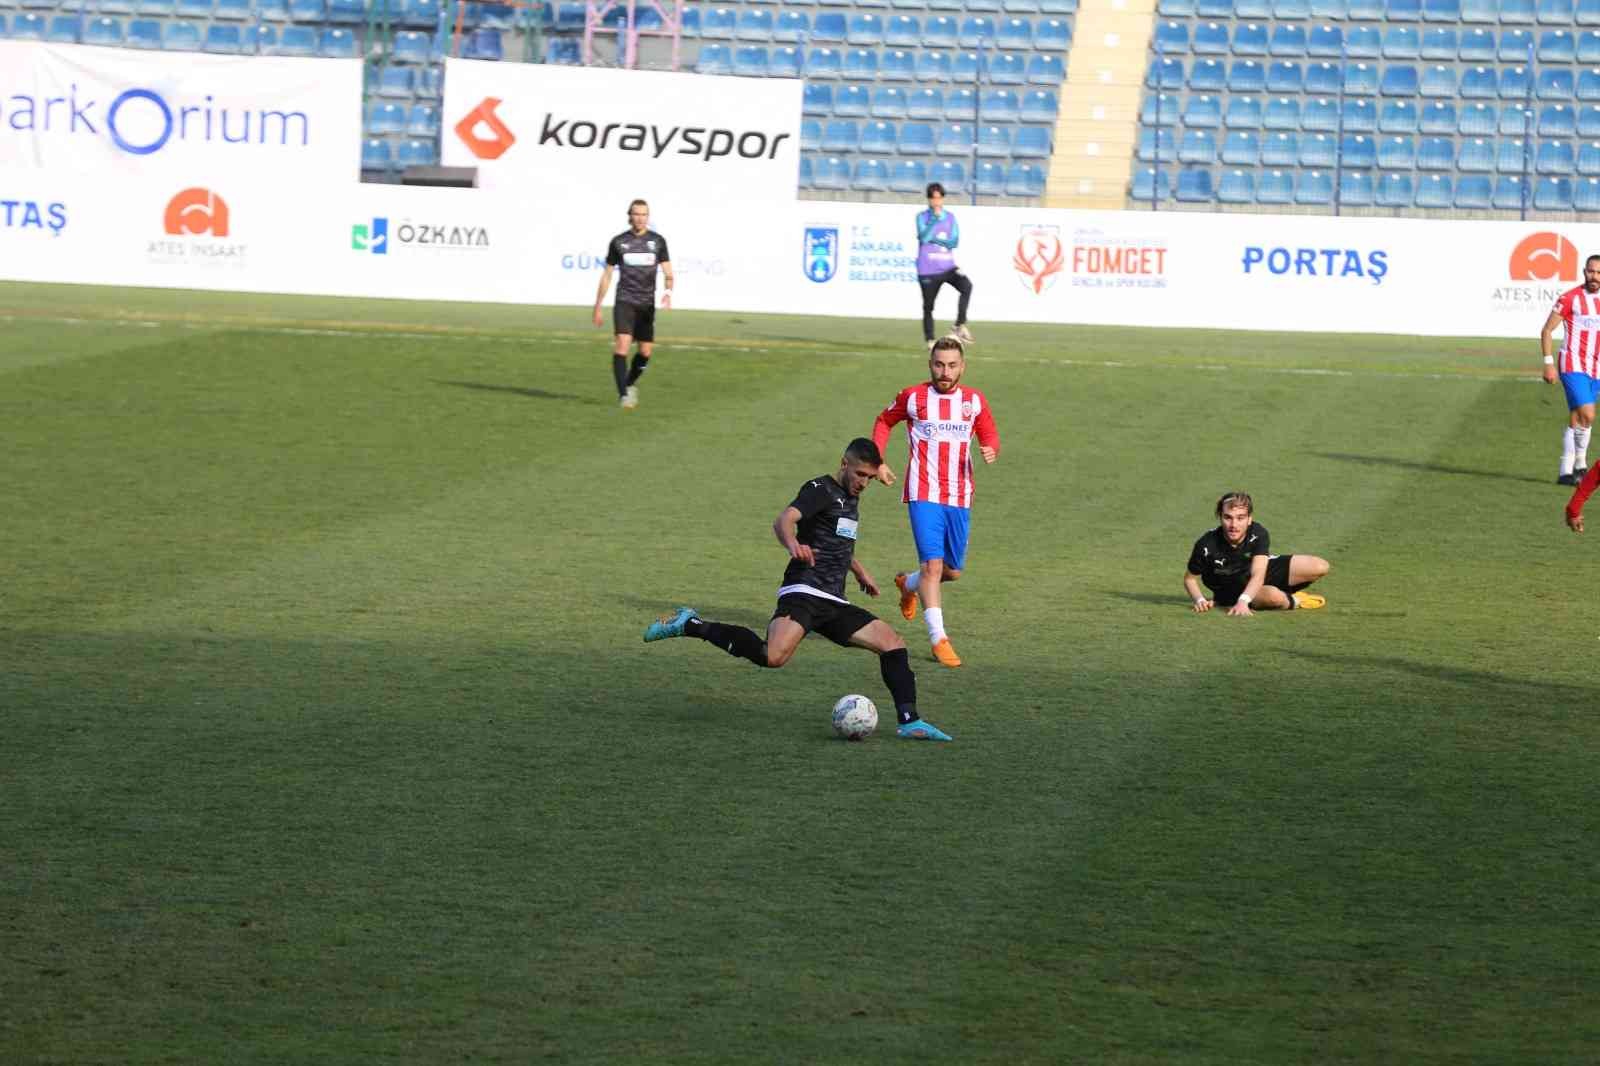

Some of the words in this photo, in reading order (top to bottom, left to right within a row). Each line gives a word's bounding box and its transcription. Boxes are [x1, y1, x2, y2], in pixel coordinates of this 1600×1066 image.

[538, 113, 790, 161] korayspor
[398, 218, 489, 246] ÖZKAYA
[1073, 246, 1167, 275] FOMGET
[1242, 246, 1388, 286] PORTAŞ
